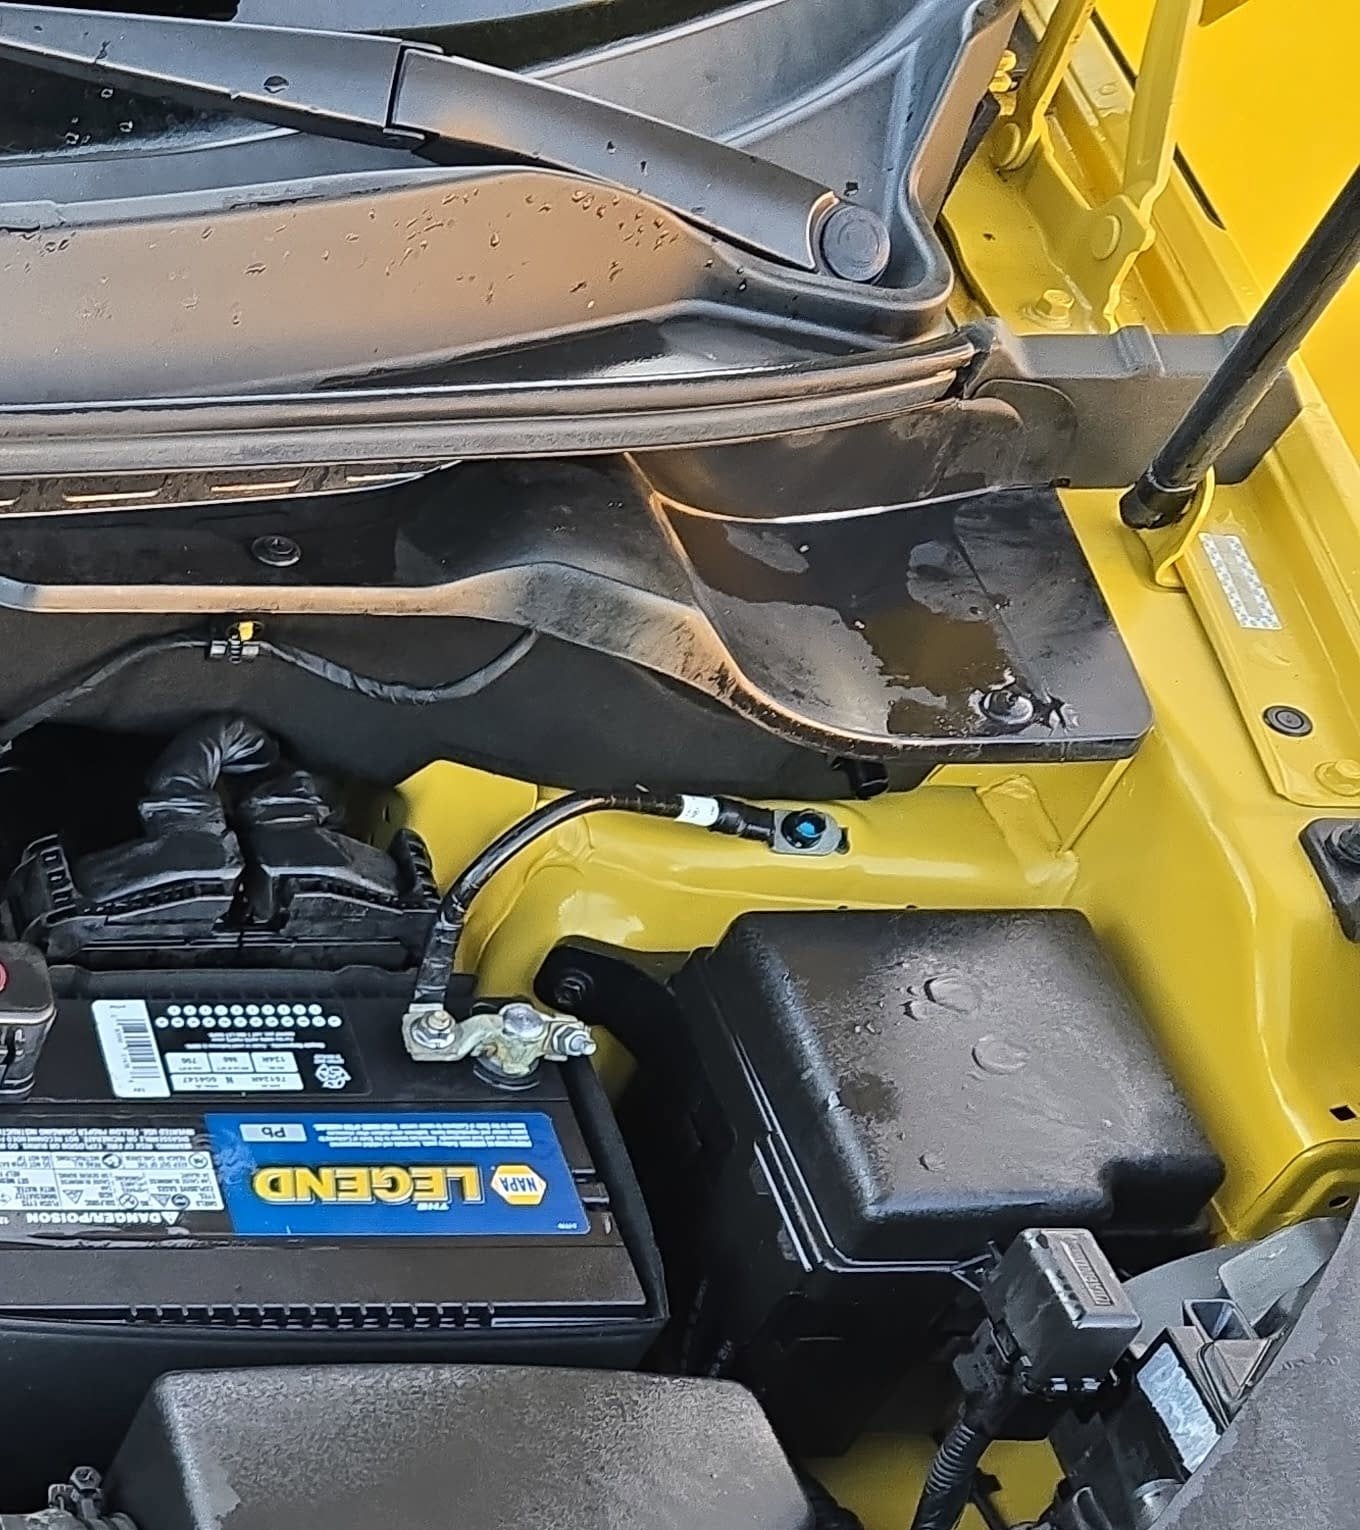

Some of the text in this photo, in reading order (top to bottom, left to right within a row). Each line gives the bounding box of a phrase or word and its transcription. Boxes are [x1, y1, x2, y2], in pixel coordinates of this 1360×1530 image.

[258, 1126, 288, 1141] Pb
[252, 1166, 483, 1204] LEGEND
[500, 1177, 539, 1193] NAPA
[417, 1202, 450, 1211] THE
[26, 1211, 163, 1224] DANGER/POISON
